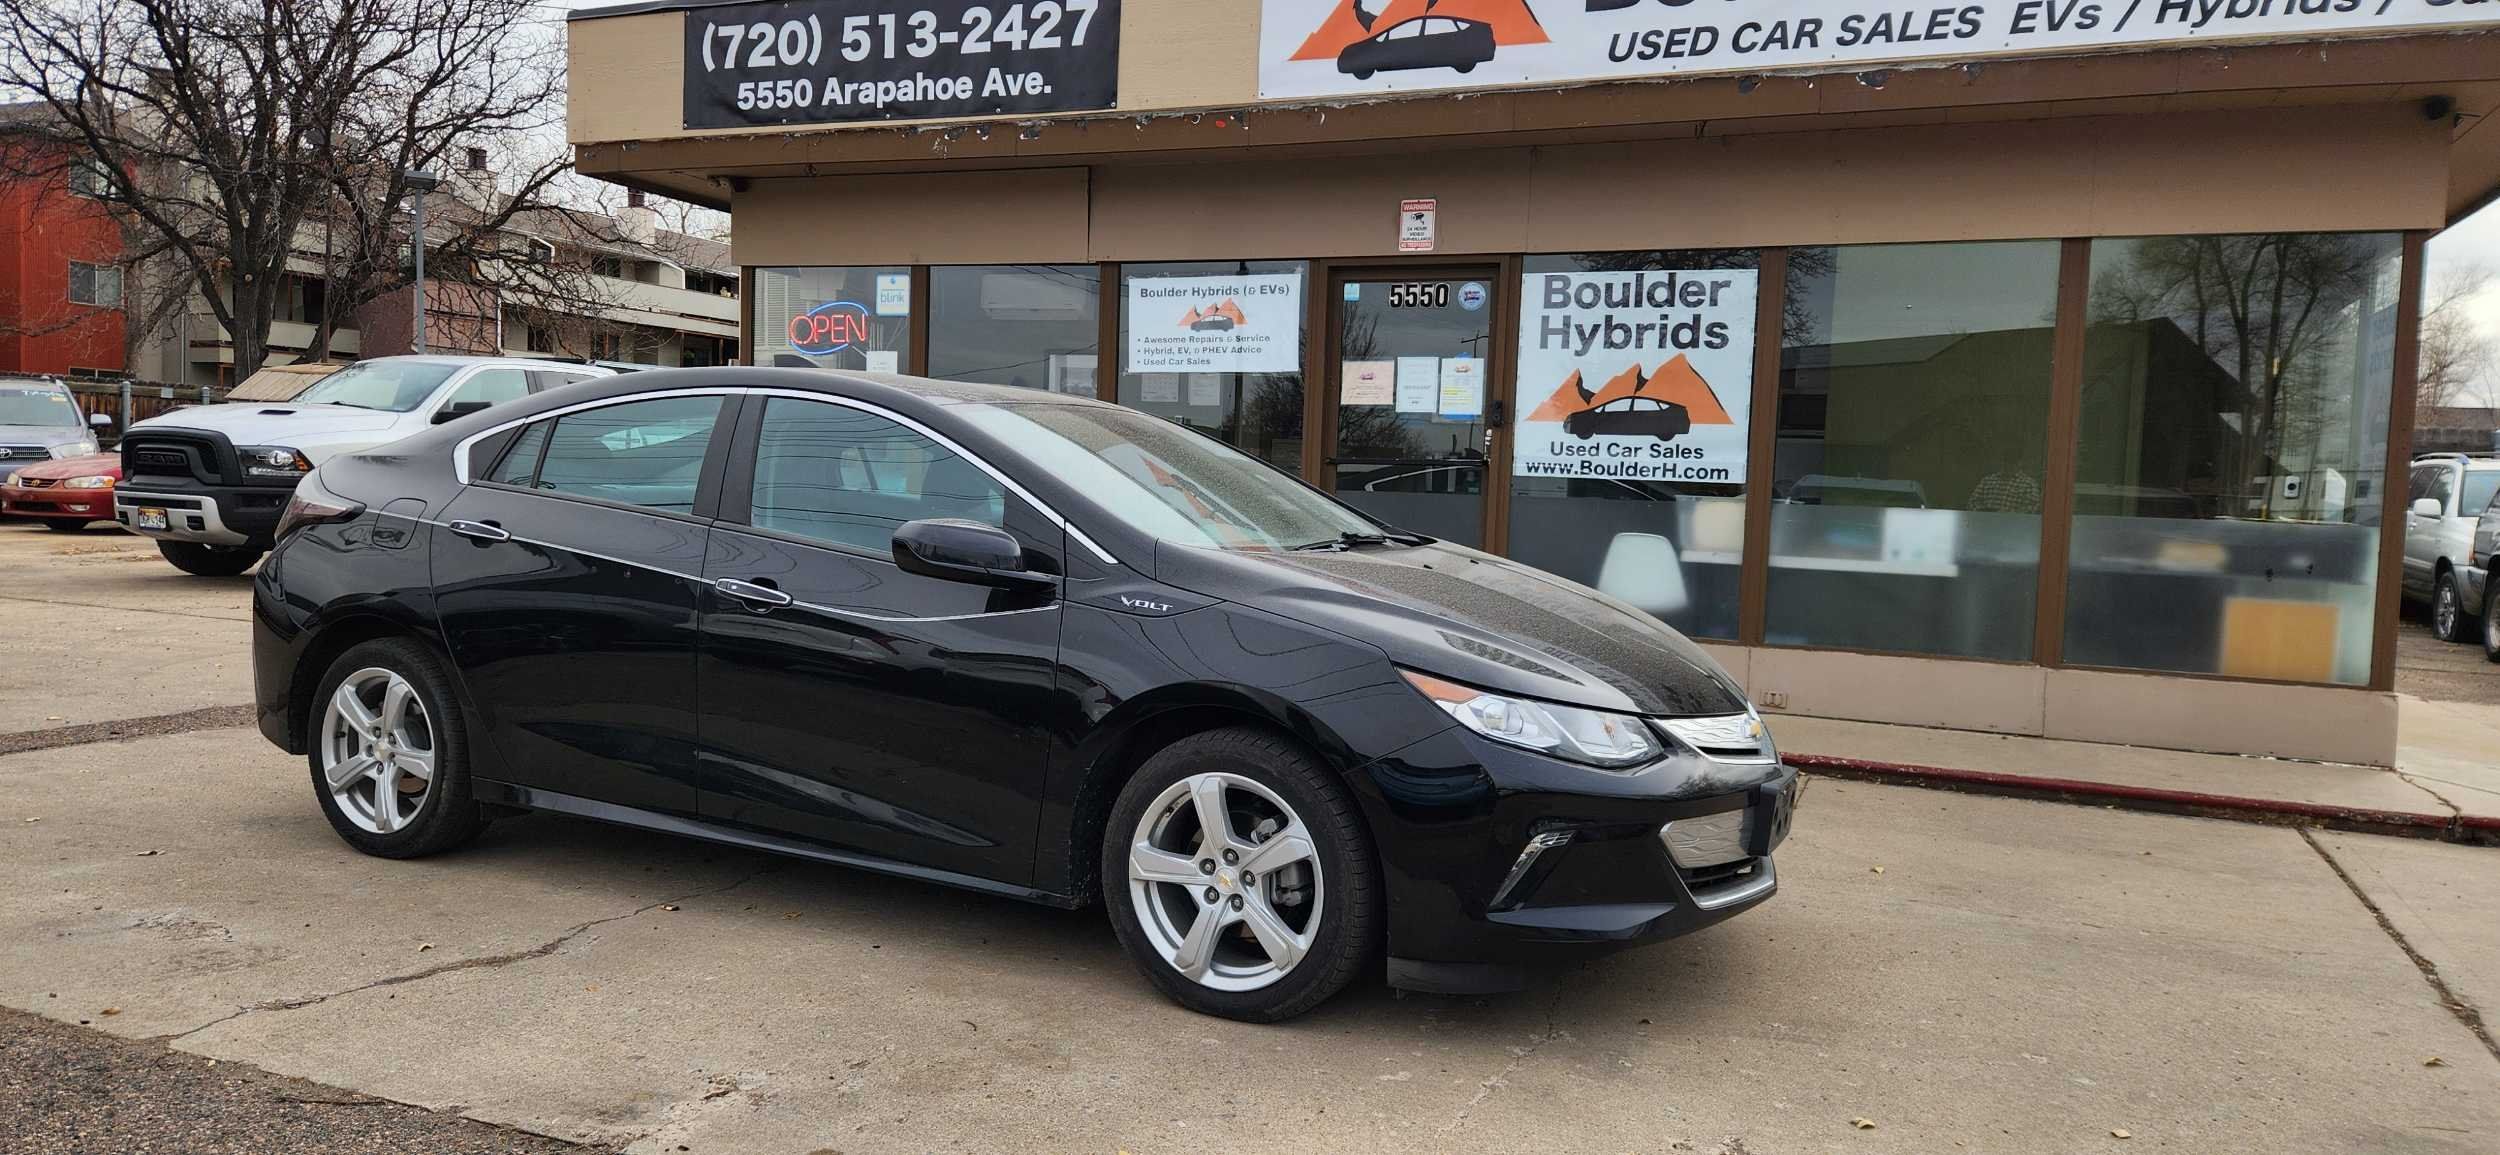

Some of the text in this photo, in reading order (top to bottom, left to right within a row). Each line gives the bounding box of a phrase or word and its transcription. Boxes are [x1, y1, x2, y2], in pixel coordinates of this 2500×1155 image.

[702, 0, 1099, 72] (720) 513-2427
[1608, 25, 1720, 63] USED
[1731, 19, 1824, 54] CAR
[1835, 5, 1984, 48] SALES
[2008, 0, 2100, 35] EVs
[736, 66, 1052, 110] 5550 Arapahoe Ave.
[1403, 203, 1433, 211] WARNING
[880, 292, 905, 304] blink
[1140, 287, 1188, 298] Boulder
[1191, 285, 1240, 299] Hybrids
[1260, 283, 1290, 296] EVs)
[1390, 283, 1450, 308] 5550
[1543, 272, 1732, 310] Boulder
[789, 313, 867, 345] OPEN
[1539, 314, 1730, 357] Hybrids
[1144, 336, 1186, 344] Awesome
[1189, 335, 1223, 345] Repairs
[1235, 334, 1271, 343] Service
[1143, 347, 1175, 357] Hybrid,
[1177, 347, 1191, 355] EV,
[1202, 346, 1228, 354] PHEV
[1230, 346, 1262, 354] Advice
[1143, 357, 1211, 366] Used Car Sales
[1550, 441, 1704, 459] Used Car Sales
[1526, 460, 1729, 481] www.BoulderH.com
[1120, 594, 1174, 612] VOLT
